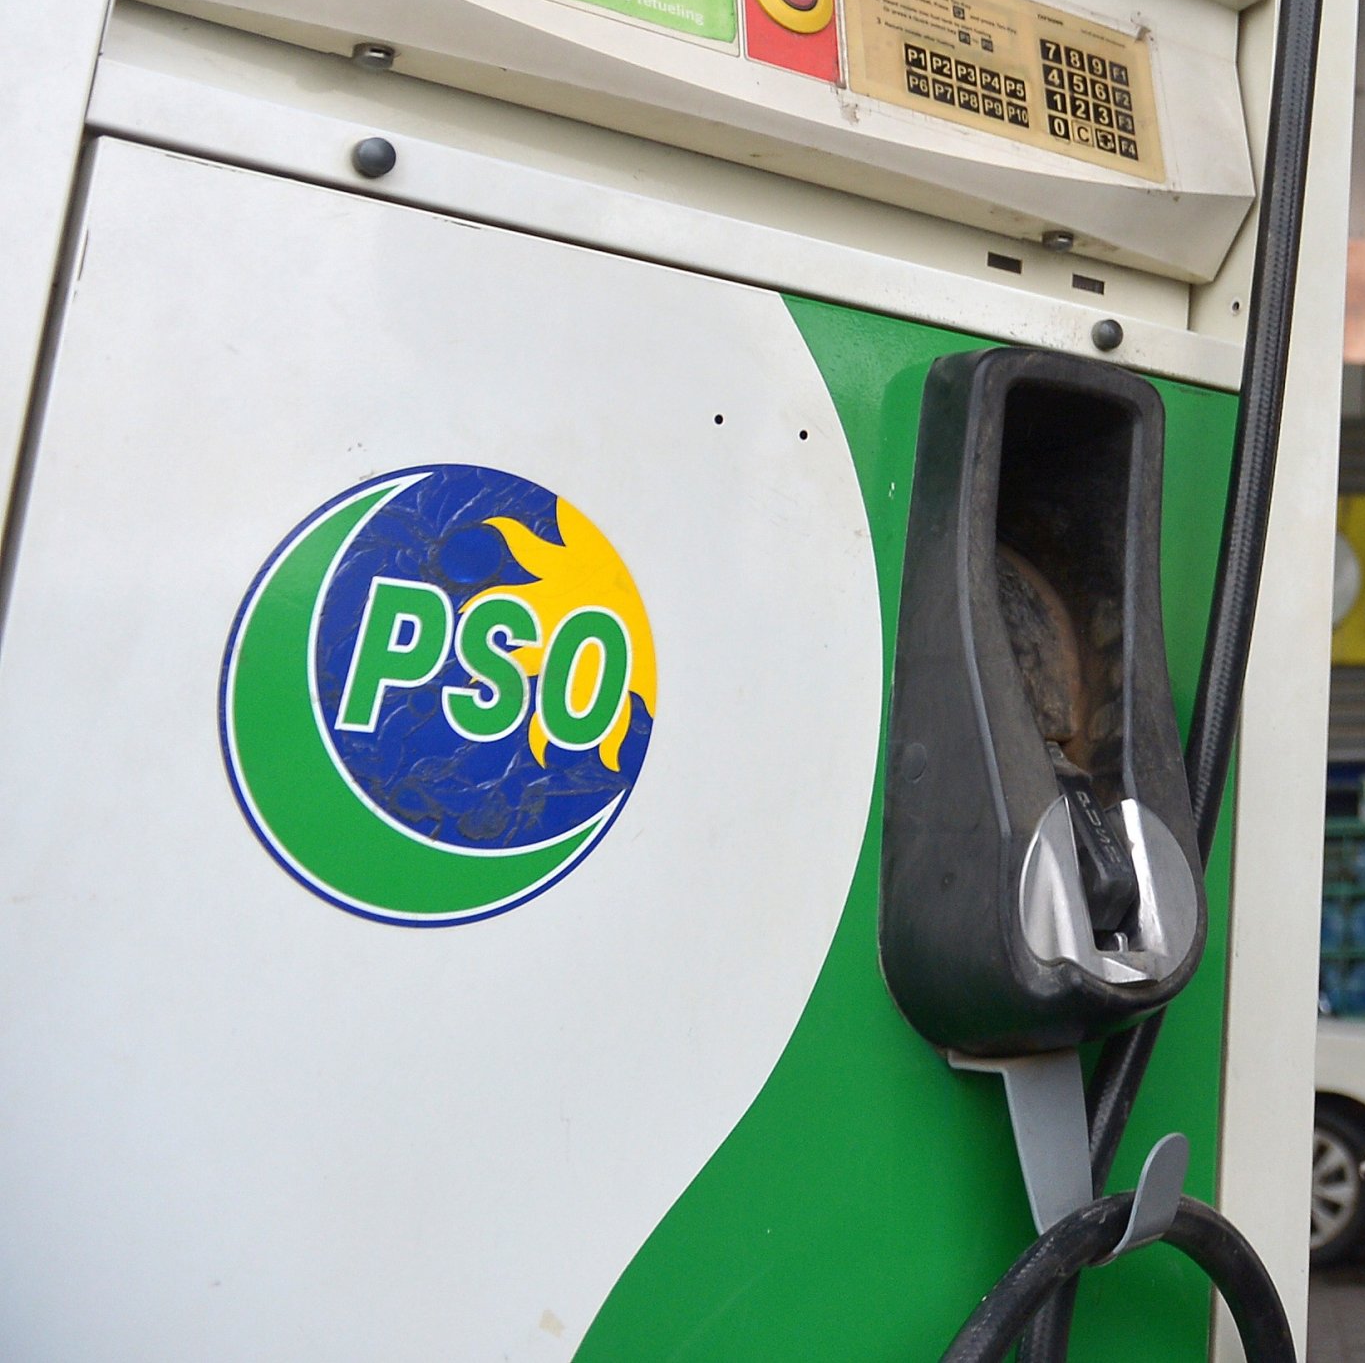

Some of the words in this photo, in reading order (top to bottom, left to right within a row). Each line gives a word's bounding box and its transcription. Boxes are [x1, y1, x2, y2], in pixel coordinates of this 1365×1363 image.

[907, 48, 925, 67] P1
[932, 57, 951, 75] P2
[957, 64, 976, 83] P3
[981, 72, 999, 90] P4
[1006, 80, 1024, 98] P5
[1045, 42, 1056, 59] 7
[1069, 50, 1080, 68] 8
[1092, 58, 1103, 75] 9
[1113, 66, 1126, 81] F1
[909, 75, 928, 93] P6
[935, 83, 953, 100] P7
[960, 91, 978, 109] P8
[985, 99, 1002, 116] P9
[1008, 106, 1028, 124] P10
[1048, 68, 1060, 86] 4
[1073, 75, 1084, 92] 5
[1095, 83, 1106, 100] 6
[1116, 91, 1130, 106] F2
[1053, 93, 1062, 111] 1
[1075, 100, 1086, 118] 2
[1098, 107, 1109, 125] 3
[1053, 118, 1065, 136] 0
[1077, 126, 1089, 143] C
[1122, 139, 1136, 155] F4
[334, 576, 632, 751] PSO
